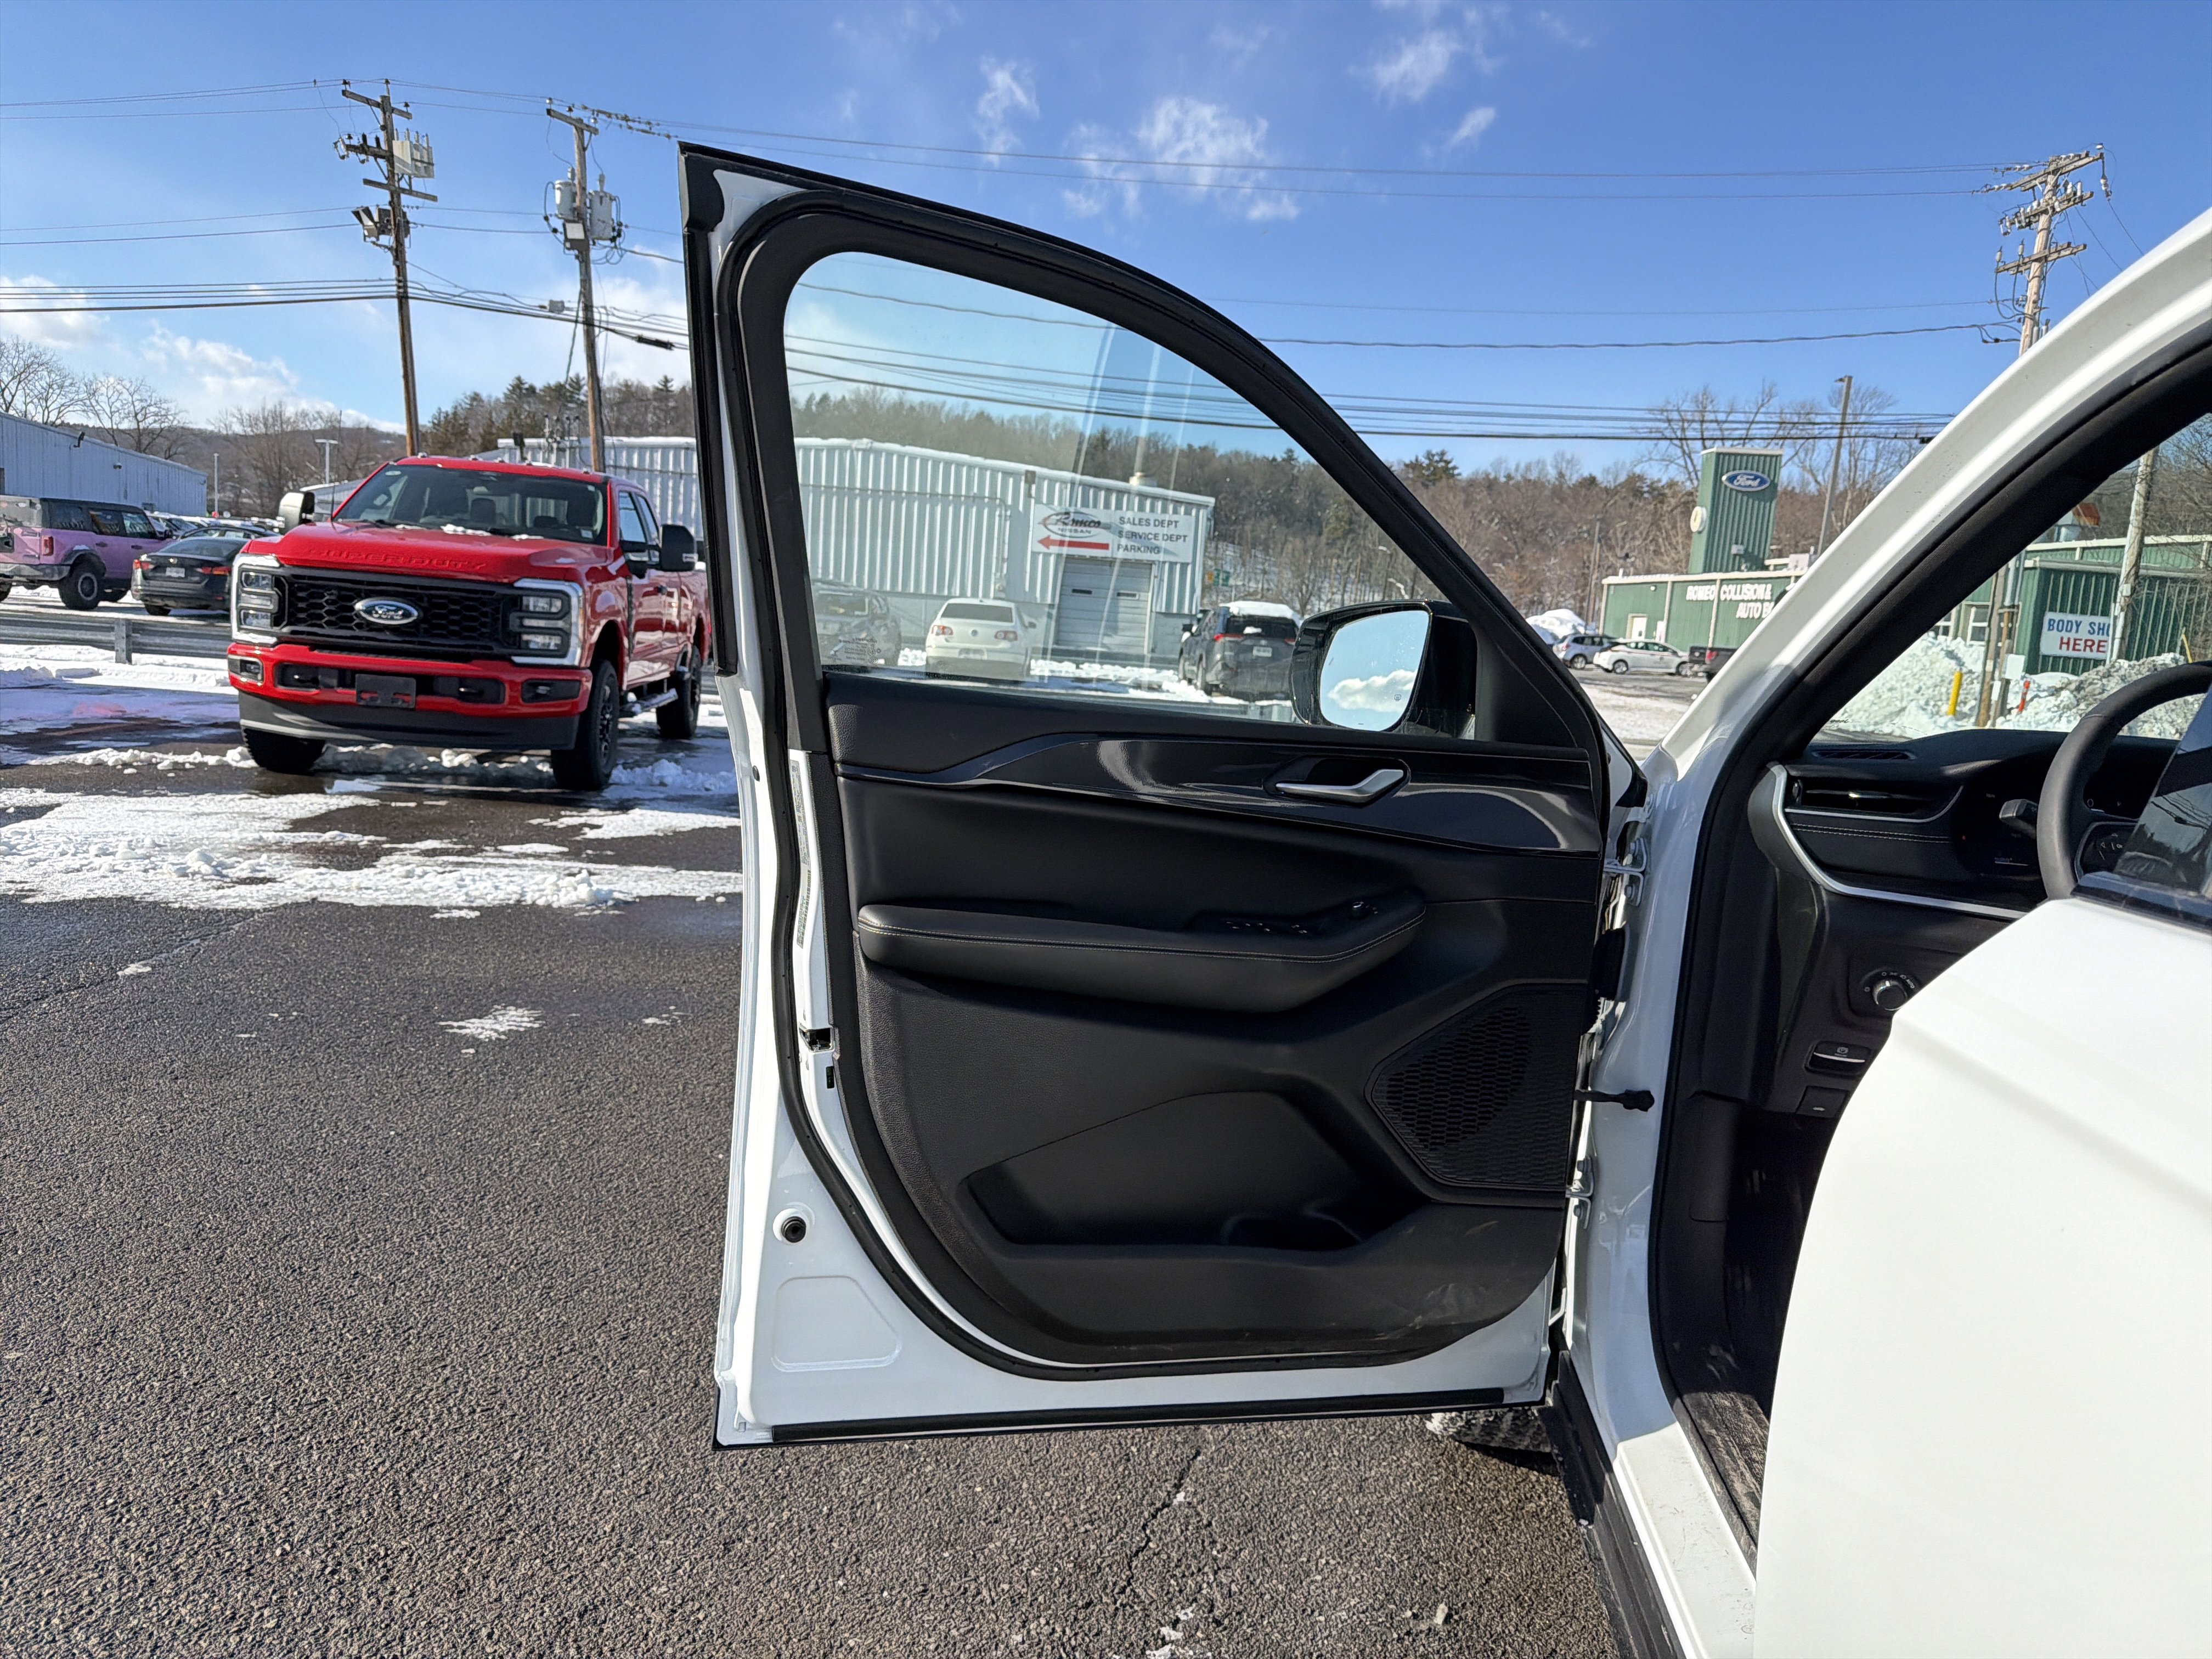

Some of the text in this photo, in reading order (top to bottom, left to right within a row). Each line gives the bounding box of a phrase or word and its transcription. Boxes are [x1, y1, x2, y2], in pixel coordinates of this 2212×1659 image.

[1734, 474, 1760, 487] Ford
[1119, 516, 1179, 528] SALES DEPT
[1118, 530, 1188, 543] SERVICE DEPT
[1117, 544, 1161, 555] PARKING
[1686, 585, 1716, 600] ROMEO
[373, 605, 404, 619] Ford
[1736, 602, 1762, 619] AUTO
[2047, 618, 2083, 634] BODY
[2059, 636, 2107, 653] HERE
